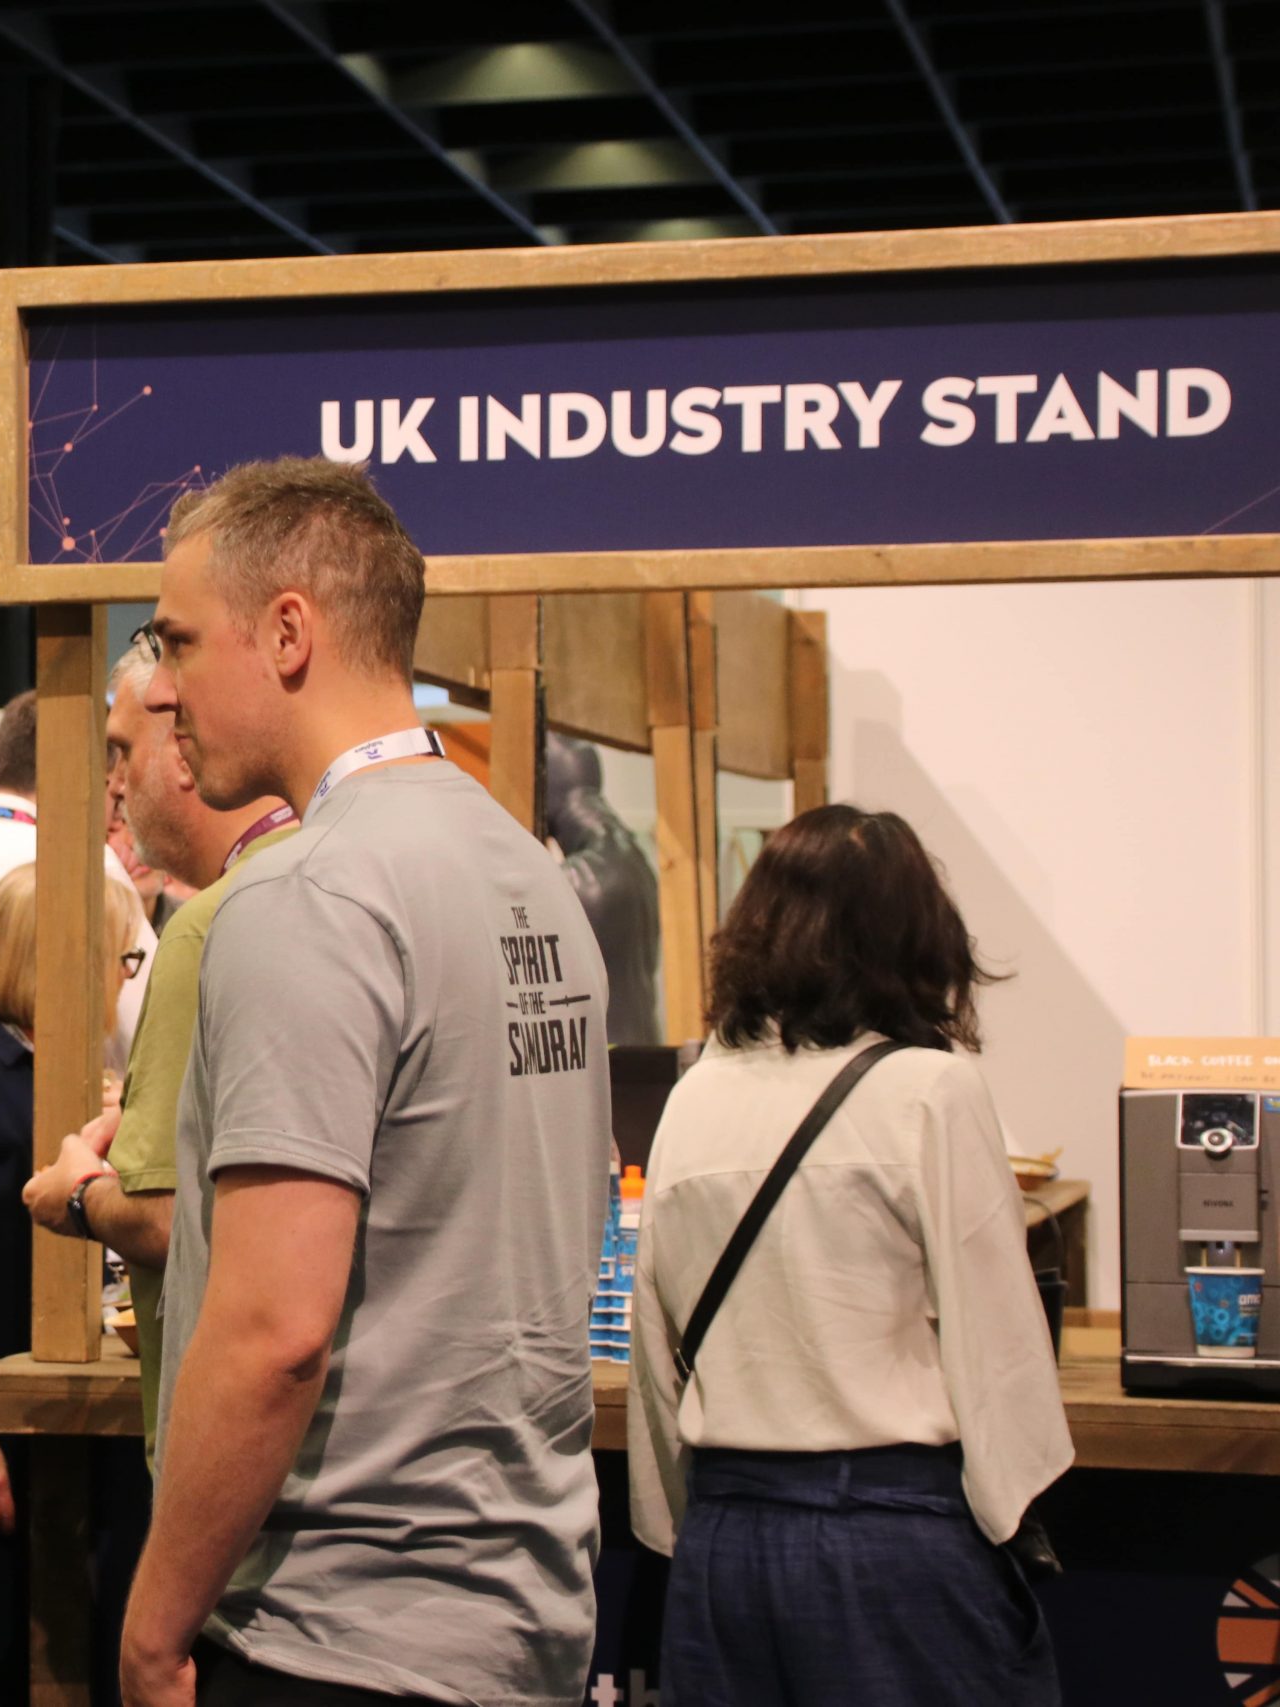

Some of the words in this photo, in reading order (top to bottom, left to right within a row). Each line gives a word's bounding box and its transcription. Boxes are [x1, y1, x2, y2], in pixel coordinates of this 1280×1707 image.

[321, 397, 438, 464] UK
[459, 380, 904, 462] INDUSTRY
[919, 367, 1232, 448] STAND
[511, 906, 530, 928] THE
[500, 934, 563, 985] SPIRIT
[519, 992, 529, 1015] OF
[529, 991, 546, 1015] THE
[508, 1017, 587, 1076] SAMURAI
